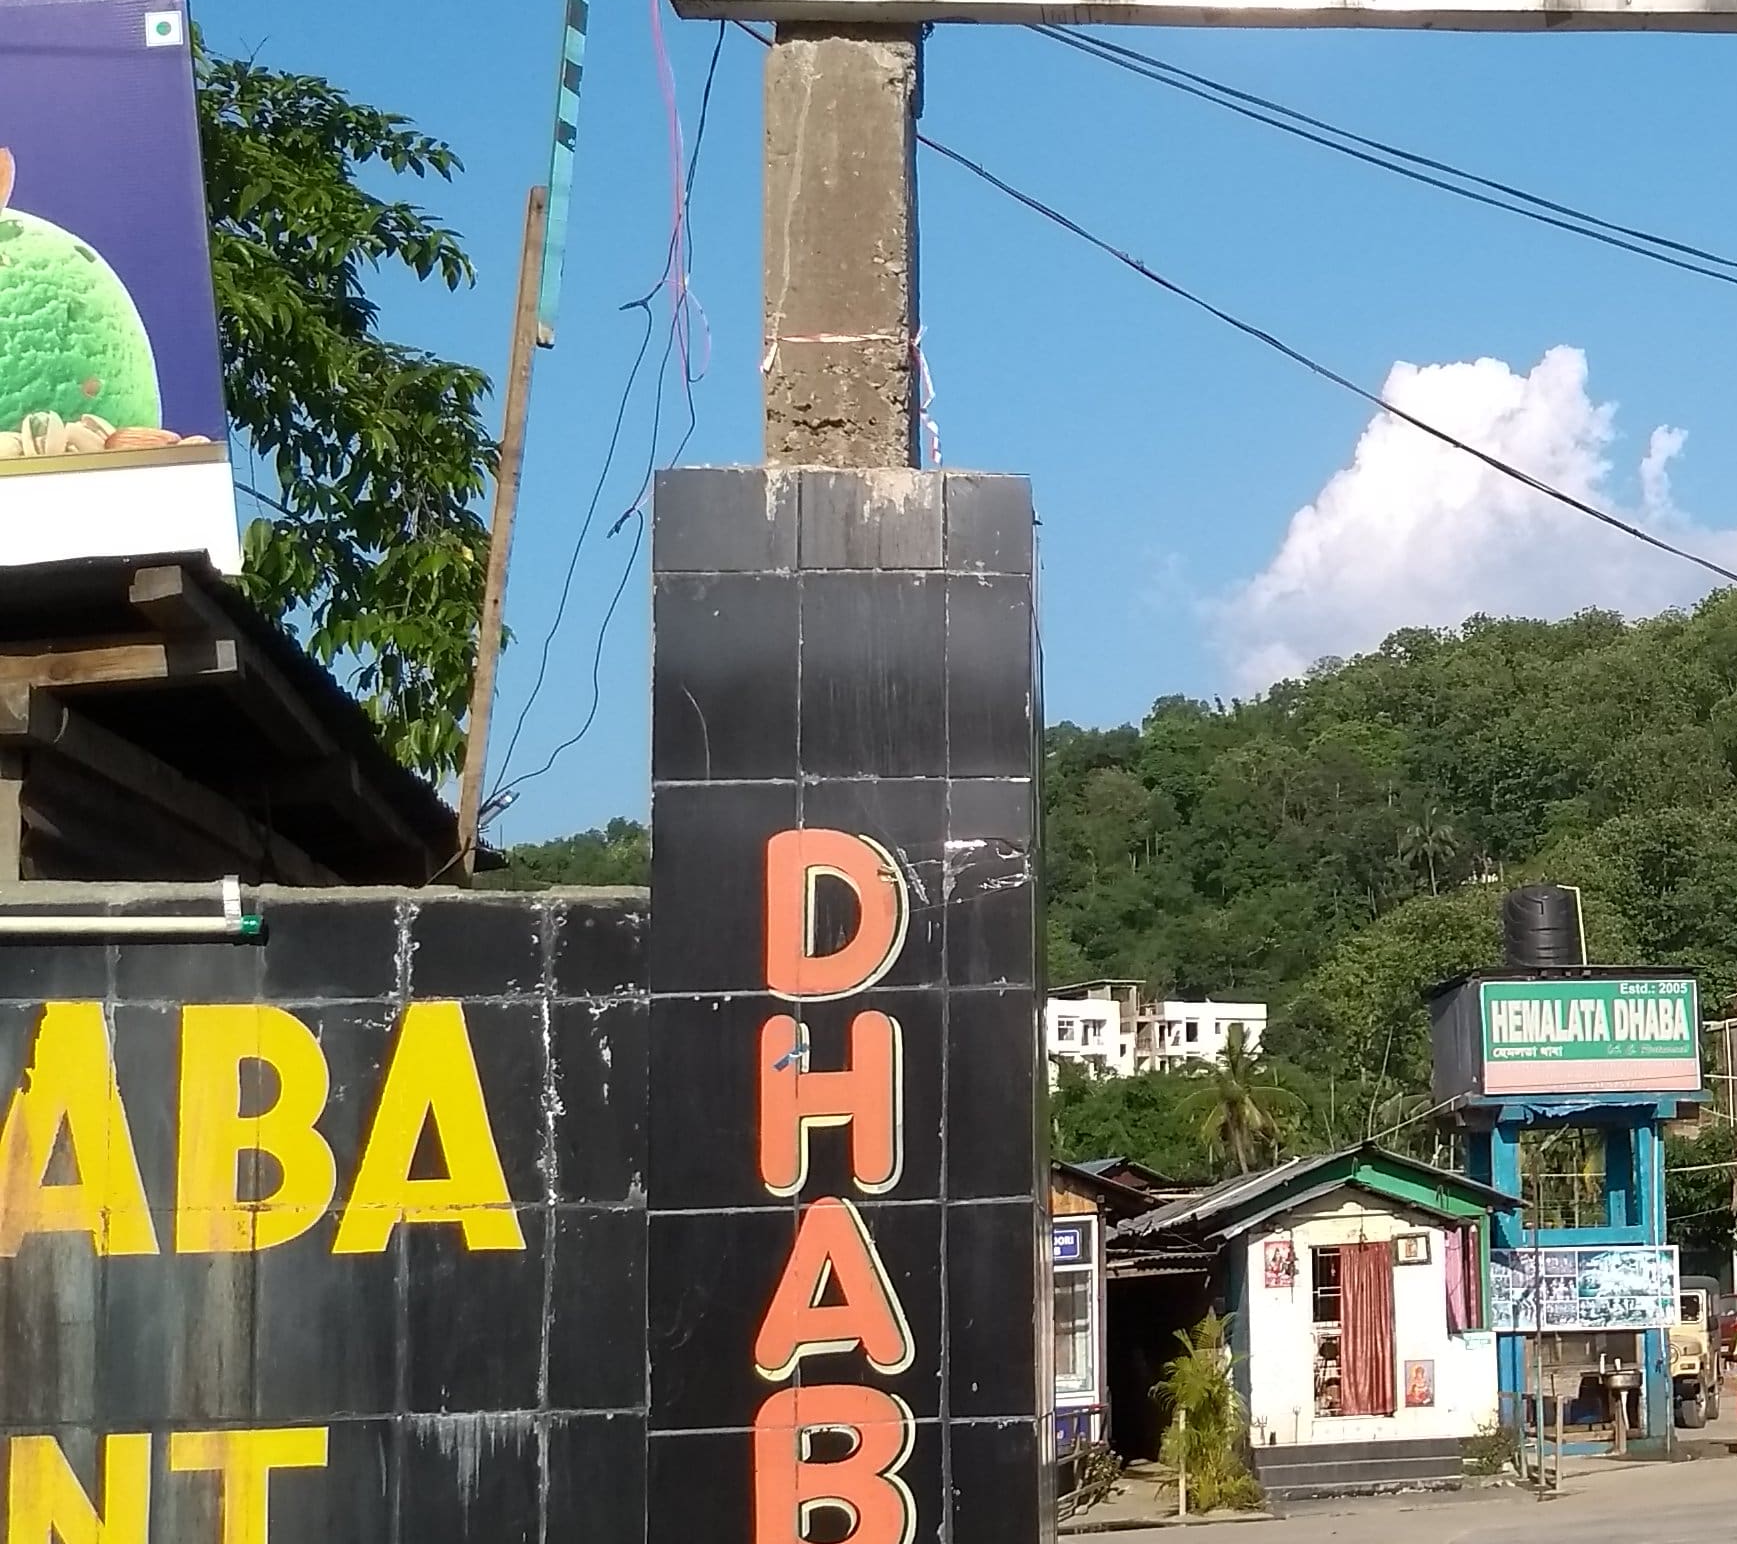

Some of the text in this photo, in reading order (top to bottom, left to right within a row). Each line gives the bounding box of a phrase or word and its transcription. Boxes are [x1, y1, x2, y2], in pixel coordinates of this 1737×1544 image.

[1659, 983, 1688, 994] 2005
[1491, 998, 1690, 1043] HEMALATA DHABA
